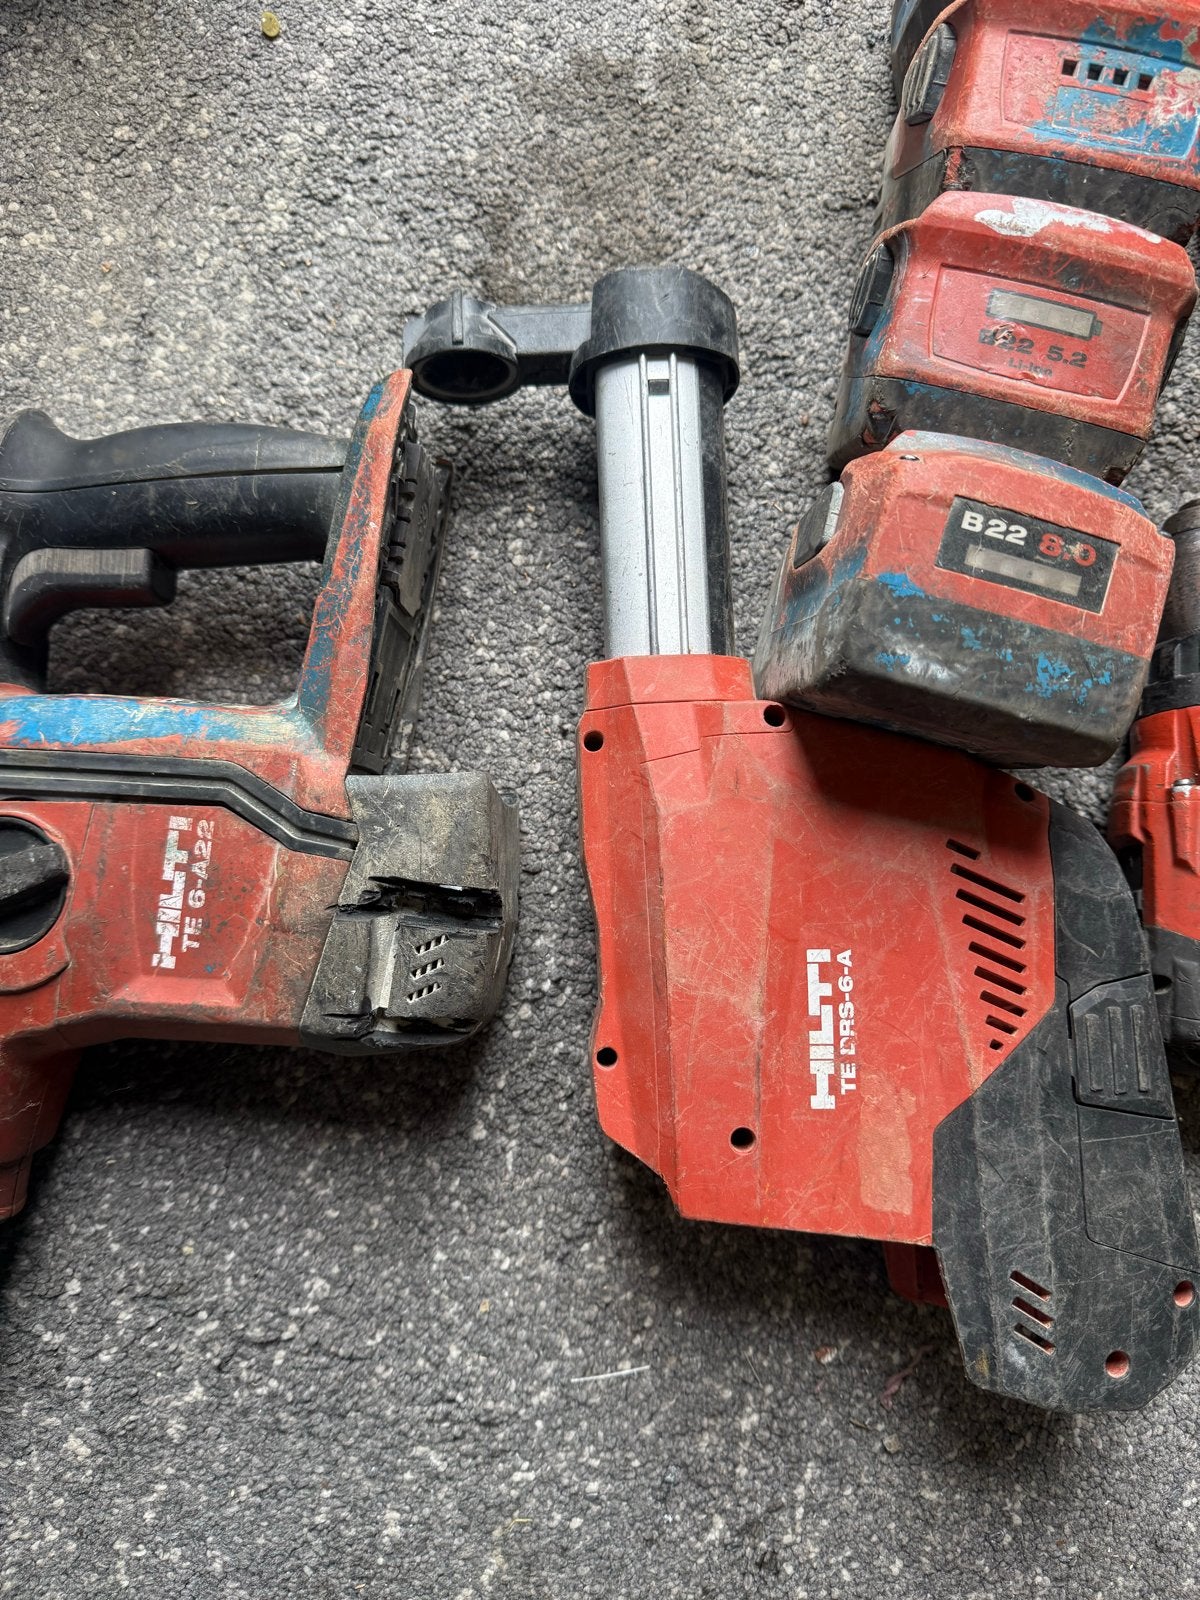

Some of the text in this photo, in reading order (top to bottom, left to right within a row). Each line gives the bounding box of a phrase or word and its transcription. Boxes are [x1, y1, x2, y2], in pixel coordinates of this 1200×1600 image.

[1046, 344, 1088, 369] 5.2
[960, 510, 1097, 567] B22 8.0
[151, 815, 193, 969] HILTI
[181, 819, 215, 953] TE 6-A22
[806, 949, 836, 1109] HILTI
[836, 949, 857, 1095] TE DRS-6-A
